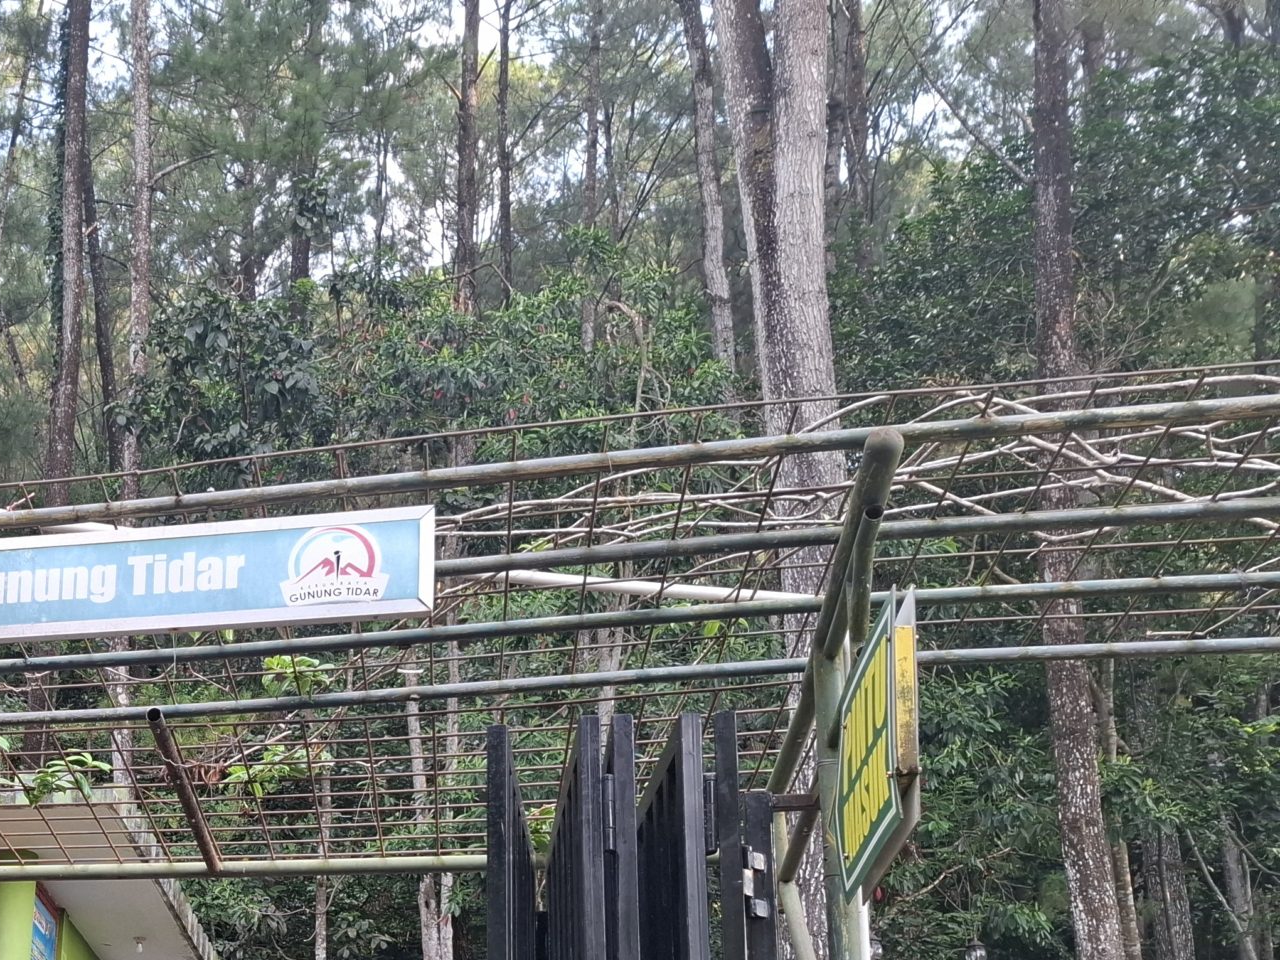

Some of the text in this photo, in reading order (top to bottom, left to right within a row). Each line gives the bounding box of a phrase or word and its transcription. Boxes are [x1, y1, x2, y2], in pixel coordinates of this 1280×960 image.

[127, 551, 246, 597] Tidar
[289, 587, 379, 603] GUNUNG TIDAR
[843, 635, 887, 796] PINTU
[843, 727, 890, 869] MASUK
